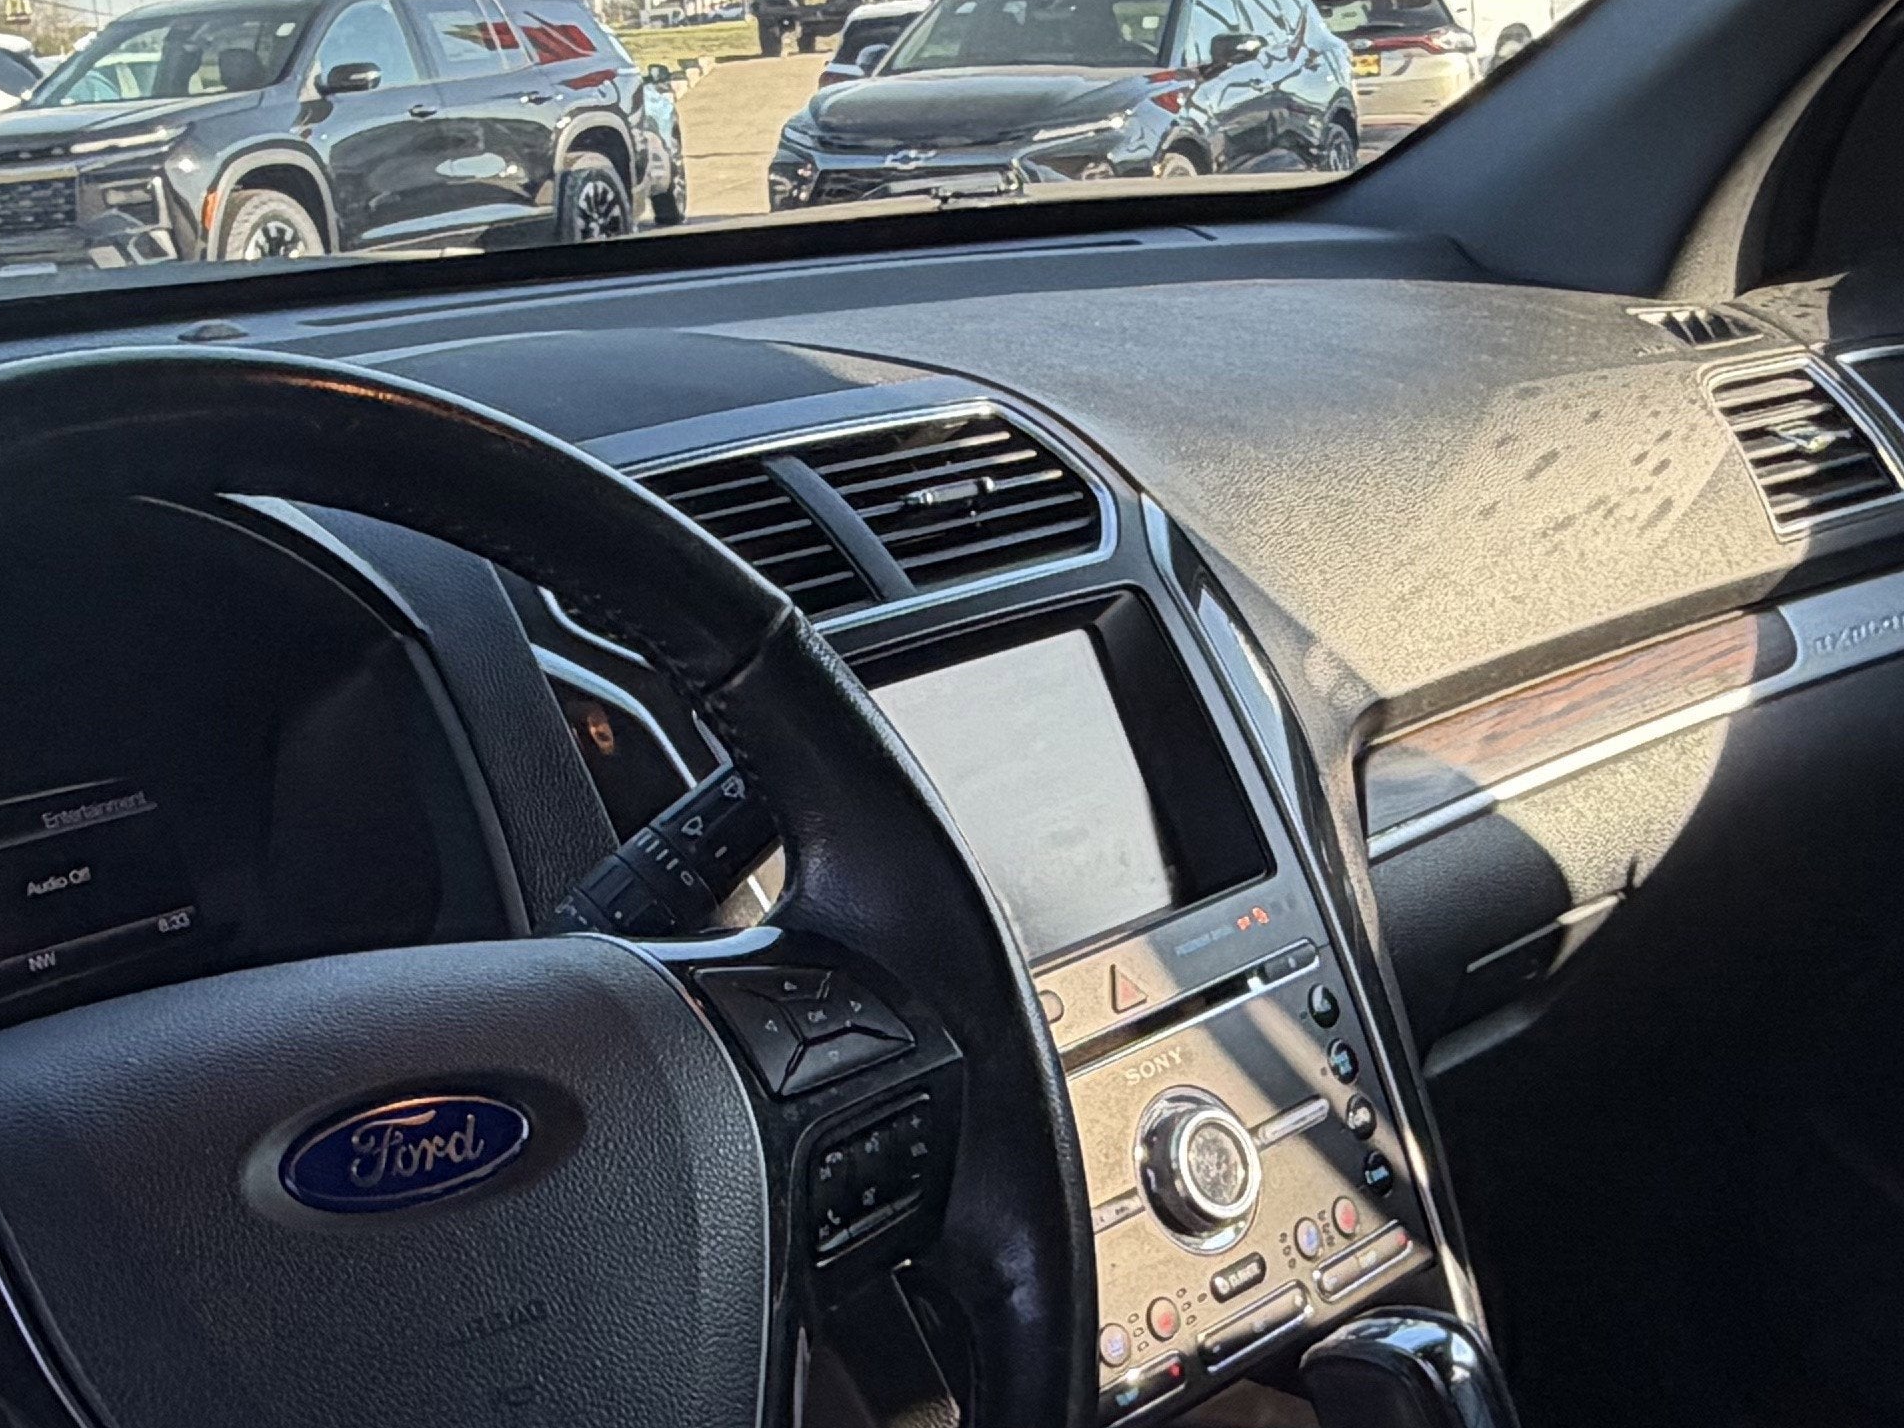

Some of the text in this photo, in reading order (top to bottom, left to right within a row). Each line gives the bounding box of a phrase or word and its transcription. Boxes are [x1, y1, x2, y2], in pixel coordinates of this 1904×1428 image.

[26, 875, 68, 898] Audio
[1125, 1046, 1182, 1086] SONY
[350, 1109, 486, 1189] Ford
